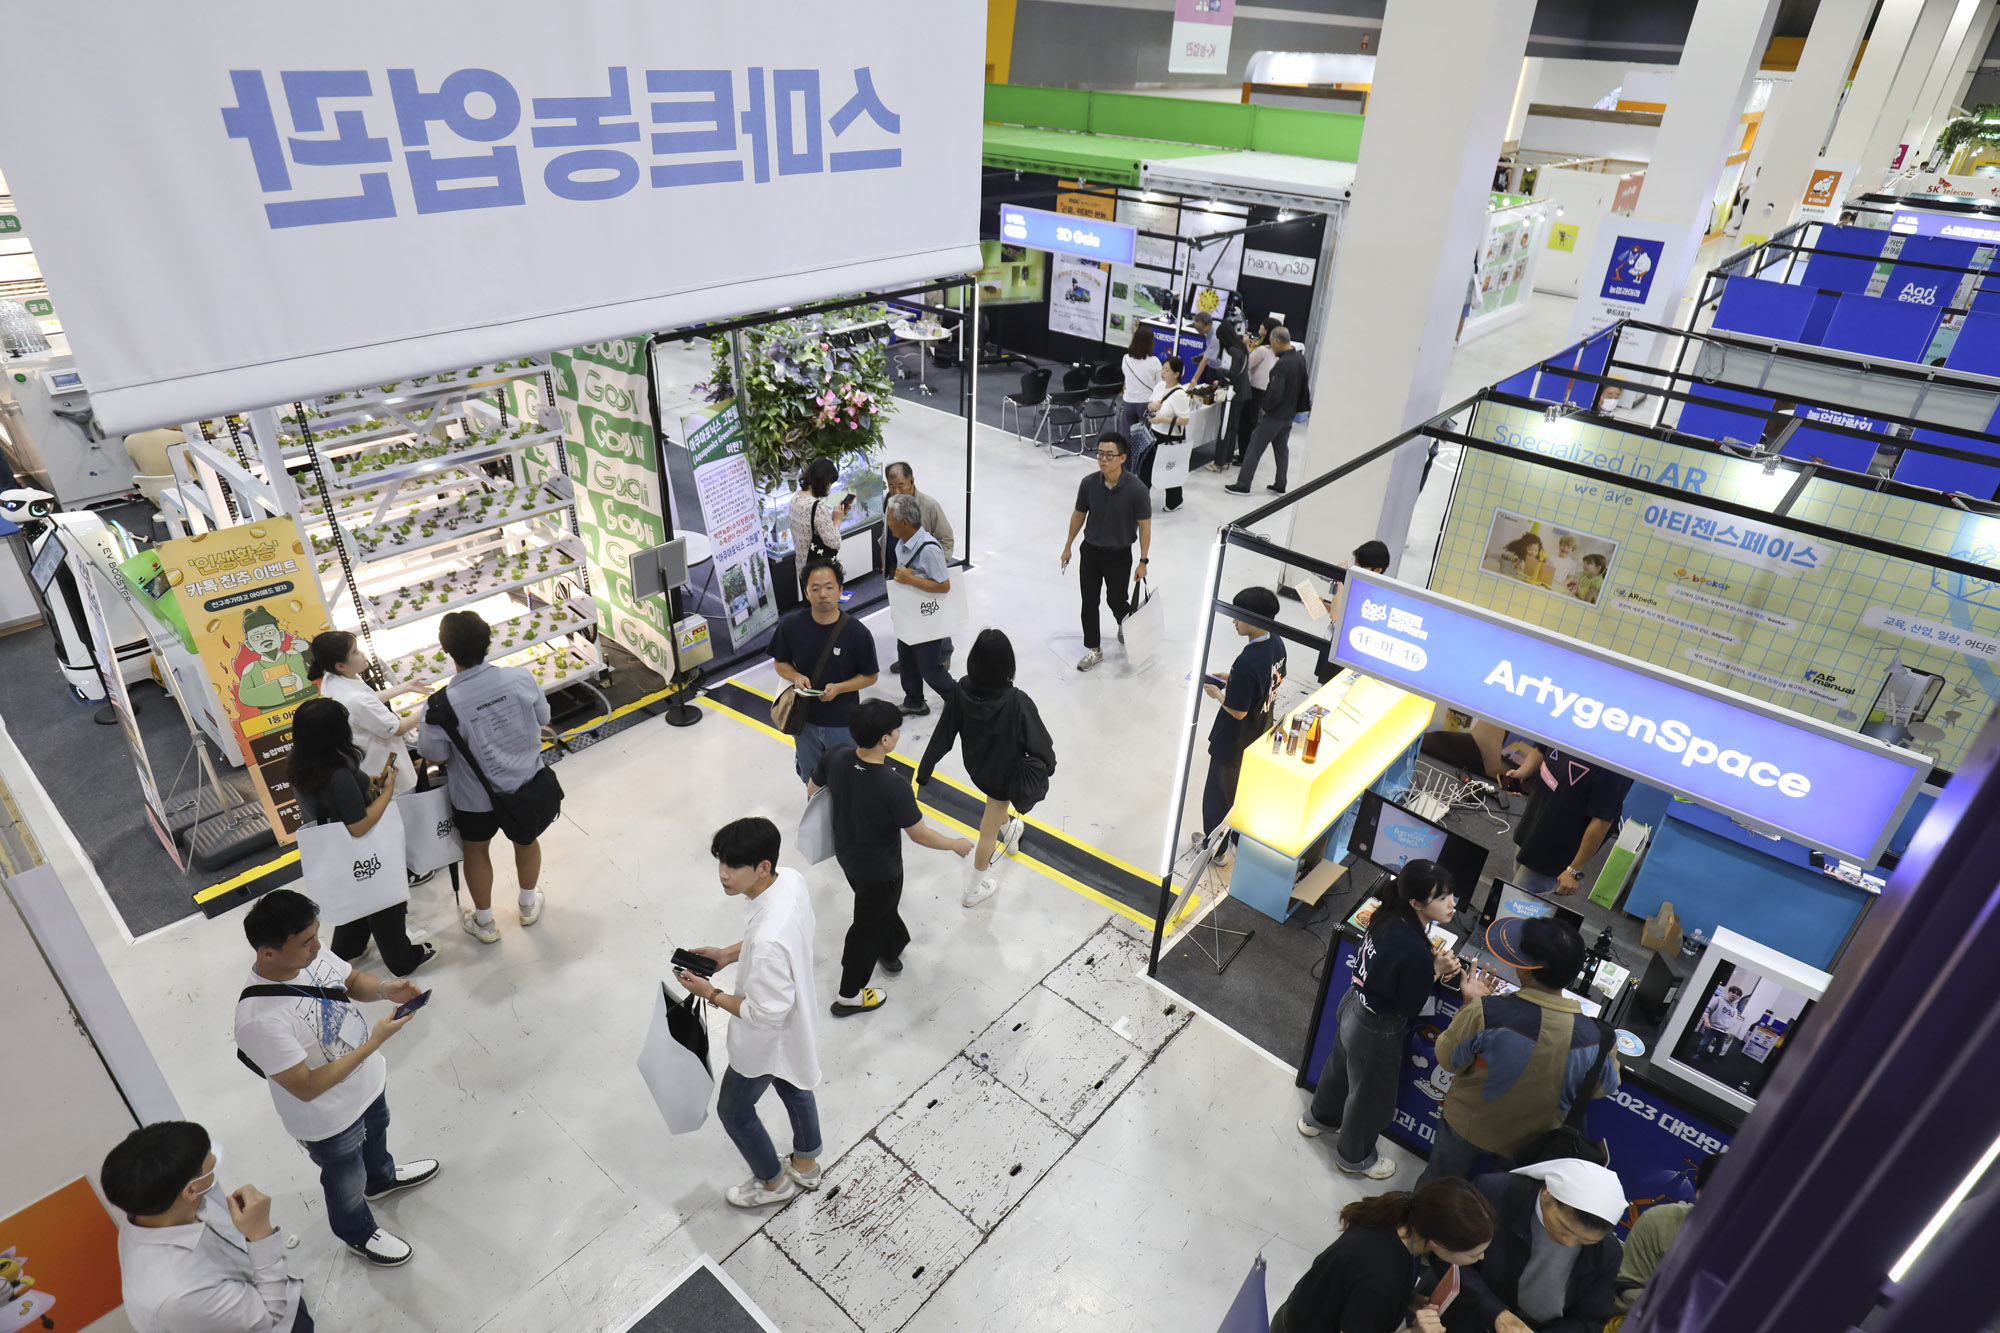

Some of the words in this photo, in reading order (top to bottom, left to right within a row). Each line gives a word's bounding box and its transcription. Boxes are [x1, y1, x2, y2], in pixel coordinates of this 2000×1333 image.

[1926, 185, 1941, 194] SK
[1943, 188, 1974, 197] telecom
[1901, 282, 1938, 297] Agri
[689, 419, 722, 452] 아쿠아포닉스
[726, 441, 743, 453] 이란?
[1493, 425, 1624, 474] Specialized
[1630, 456, 1652, 481] in
[1656, 461, 1708, 495] AR
[1574, 483, 1598, 497] we
[1604, 489, 1634, 506] are
[1644, 504, 1819, 570] 아티젠스페이스
[103, 547, 114, 560] EV
[185, 577, 218, 598] 카톡
[218, 570, 252, 590] 친추
[253, 559, 299, 581] 이벤트
[1692, 574, 1731, 591] bookar
[211, 593, 250, 609] 친구추가하고
[250, 587, 275, 600] 아이패드
[920, 598, 938, 610] Agri
[1628, 592, 1658, 607] ARpedia
[921, 604, 940, 616] expo
[1883, 616, 1906, 631] 교육,
[1910, 623, 1933, 639] 산업,
[1937, 630, 1961, 646] 일상,
[1965, 638, 1998, 655] 어디든
[1357, 631, 1421, 665] 1F-마-16
[1815, 671, 1836, 683] AR
[1813, 678, 1856, 696] manual
[476, 695, 507, 711] WORKSHEET
[267, 714, 281, 725] 1등
[1483, 657, 1811, 798] ArtygenSpace
[353, 853, 378, 872] Agri
[354, 860, 381, 879] expo
[1606, 1088, 1658, 1121] 2023
[1392, 1108, 1417, 1132] 과
[1418, 1124, 1437, 1146] 미
